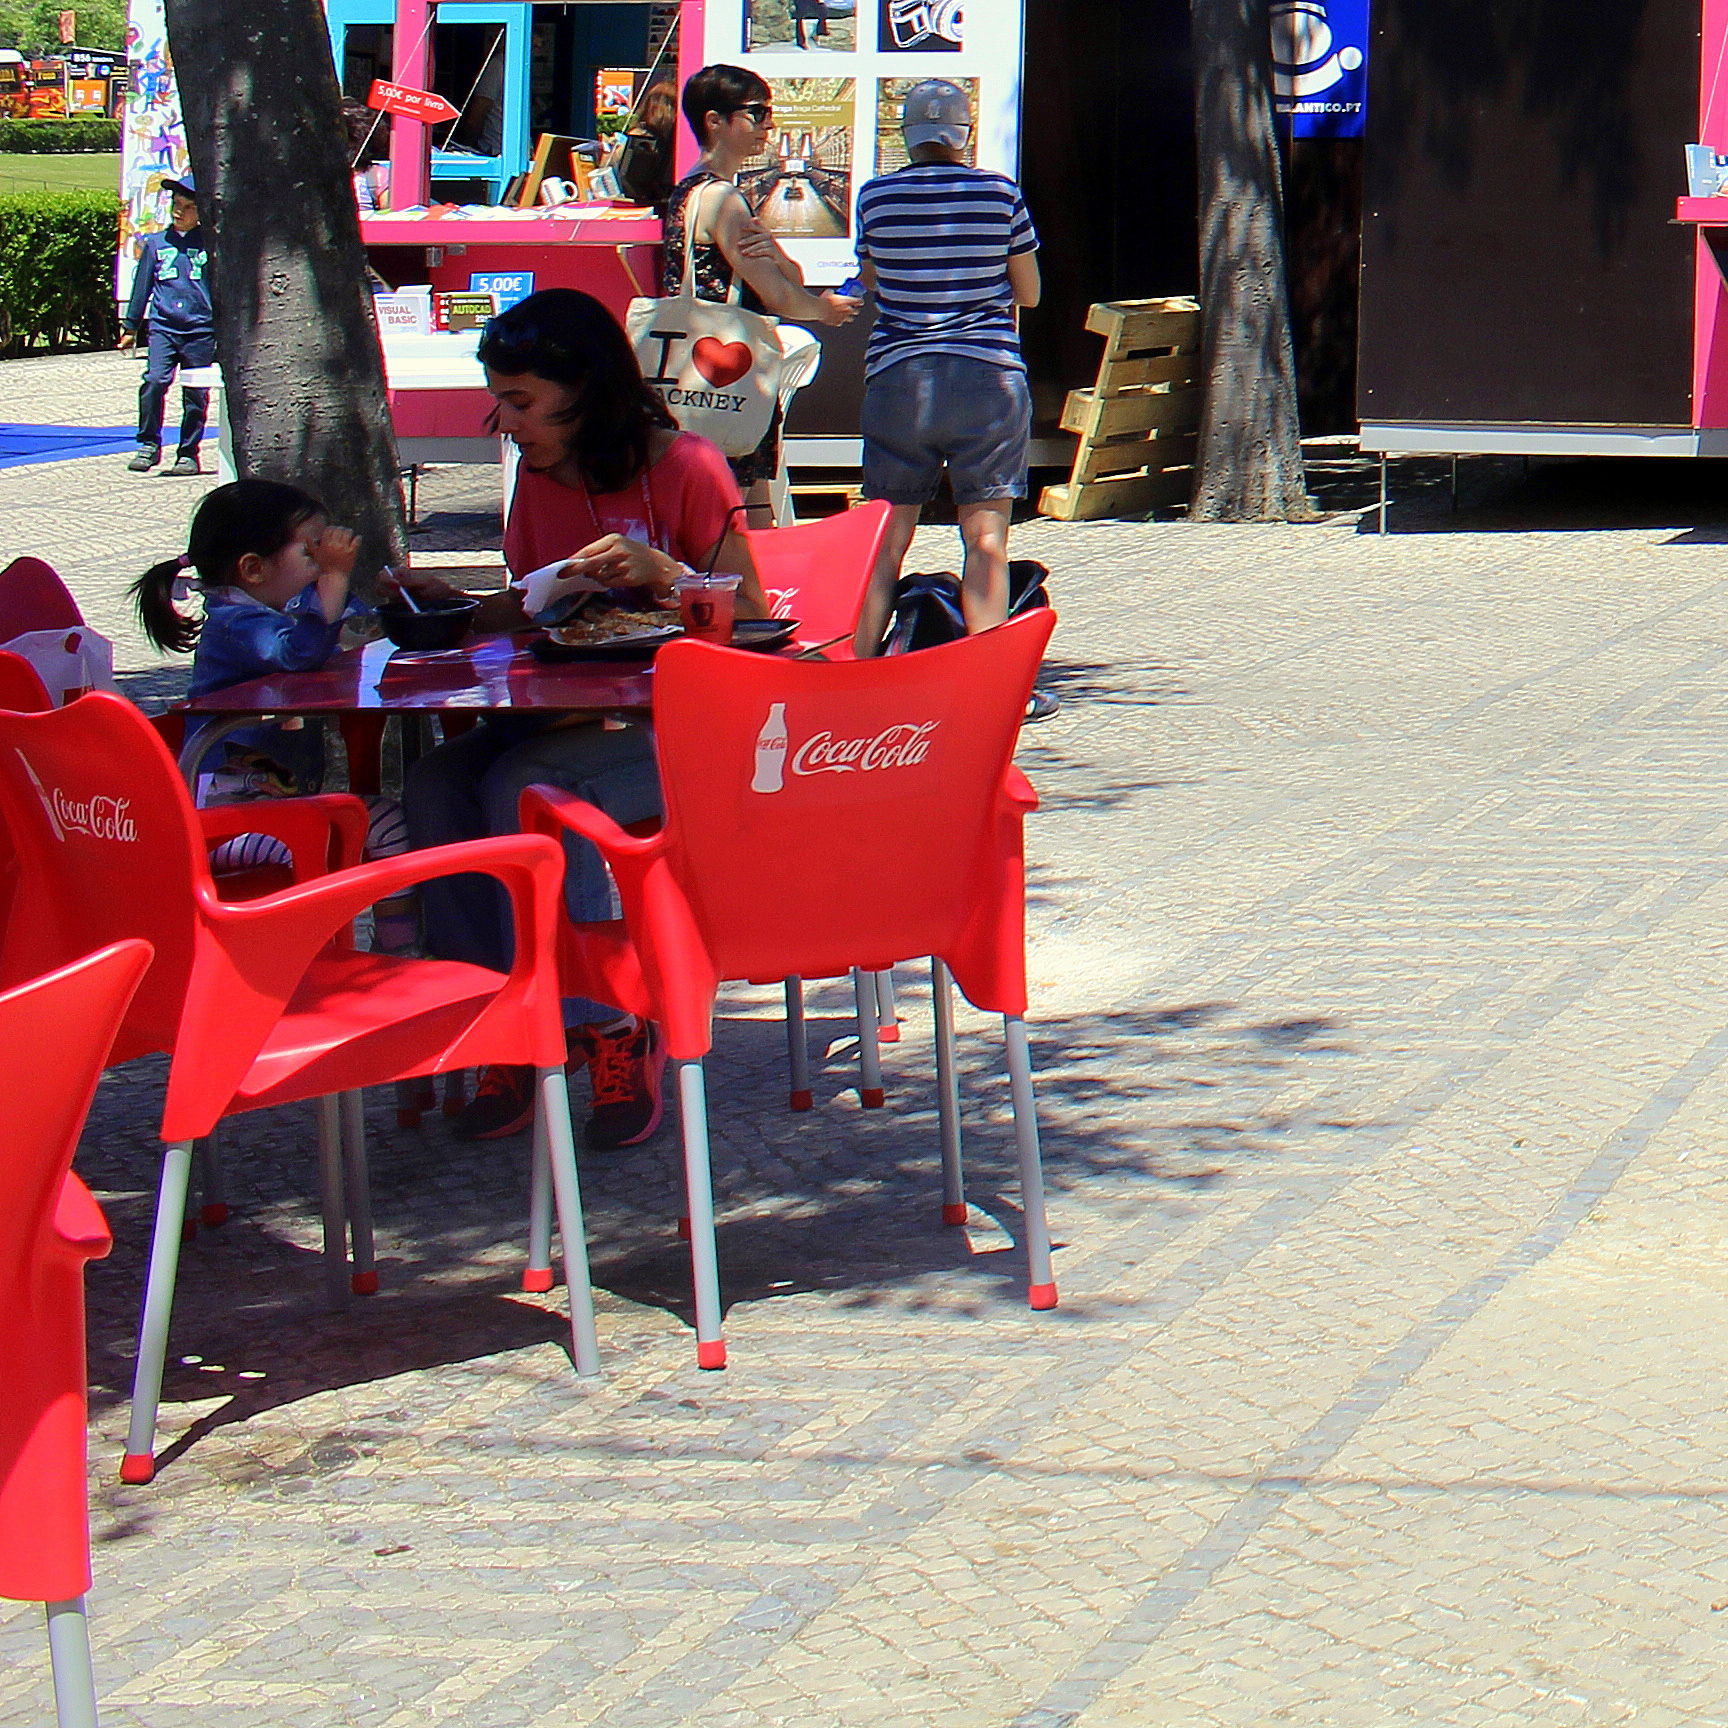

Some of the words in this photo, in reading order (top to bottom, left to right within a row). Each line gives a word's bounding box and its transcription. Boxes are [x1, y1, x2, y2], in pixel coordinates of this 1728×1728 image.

[378, 305, 412, 315] VISUAL
[387, 315, 418, 325] BASIC
[645, 330, 687, 385] I
[656, 388, 747, 413] CKNEY
[791, 720, 941, 776] Coca-Cola
[52, 787, 138, 842] Coca-Cola
